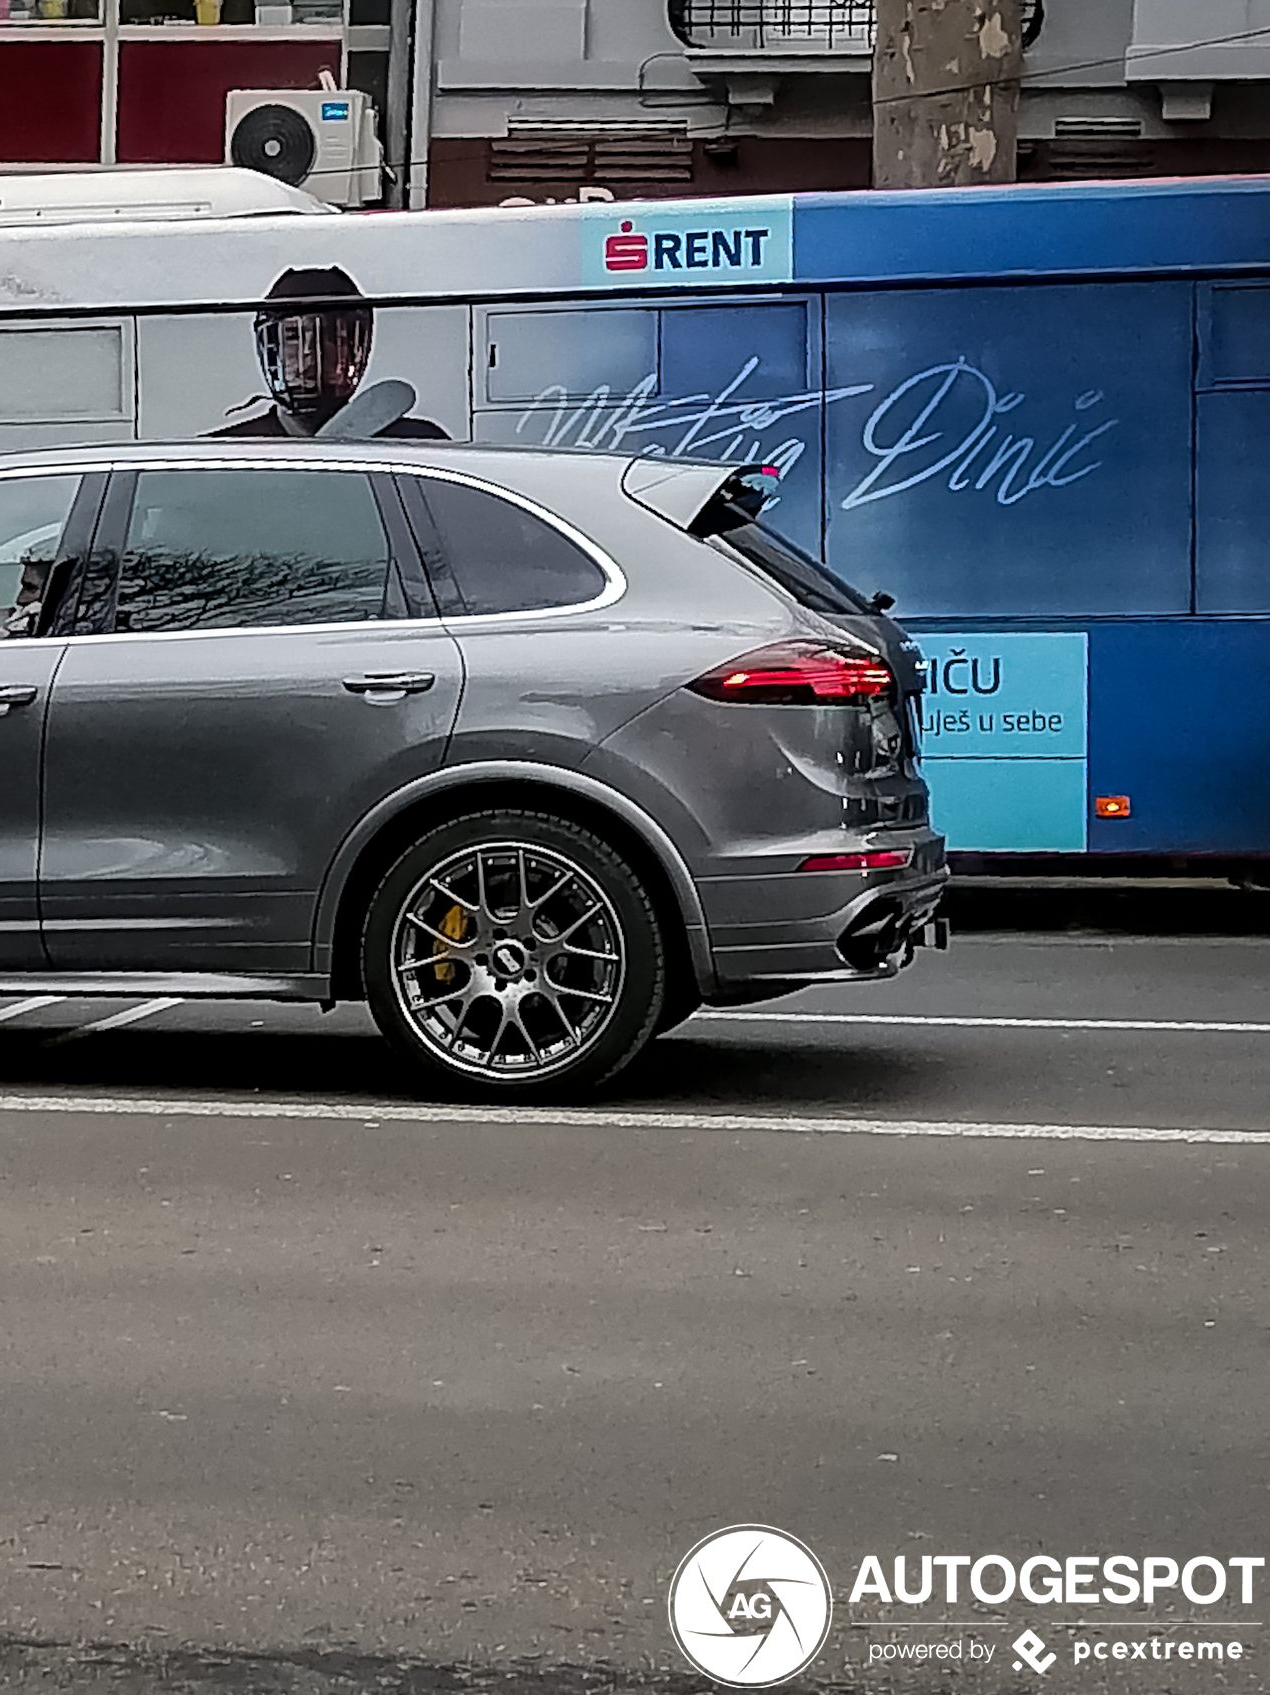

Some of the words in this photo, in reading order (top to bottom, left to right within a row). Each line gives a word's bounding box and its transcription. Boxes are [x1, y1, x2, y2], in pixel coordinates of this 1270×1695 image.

[653, 229, 769, 271] RENT
[924, 648, 1001, 695] IČU
[979, 713, 994, 732] u
[1002, 709, 1063, 733] sebe
